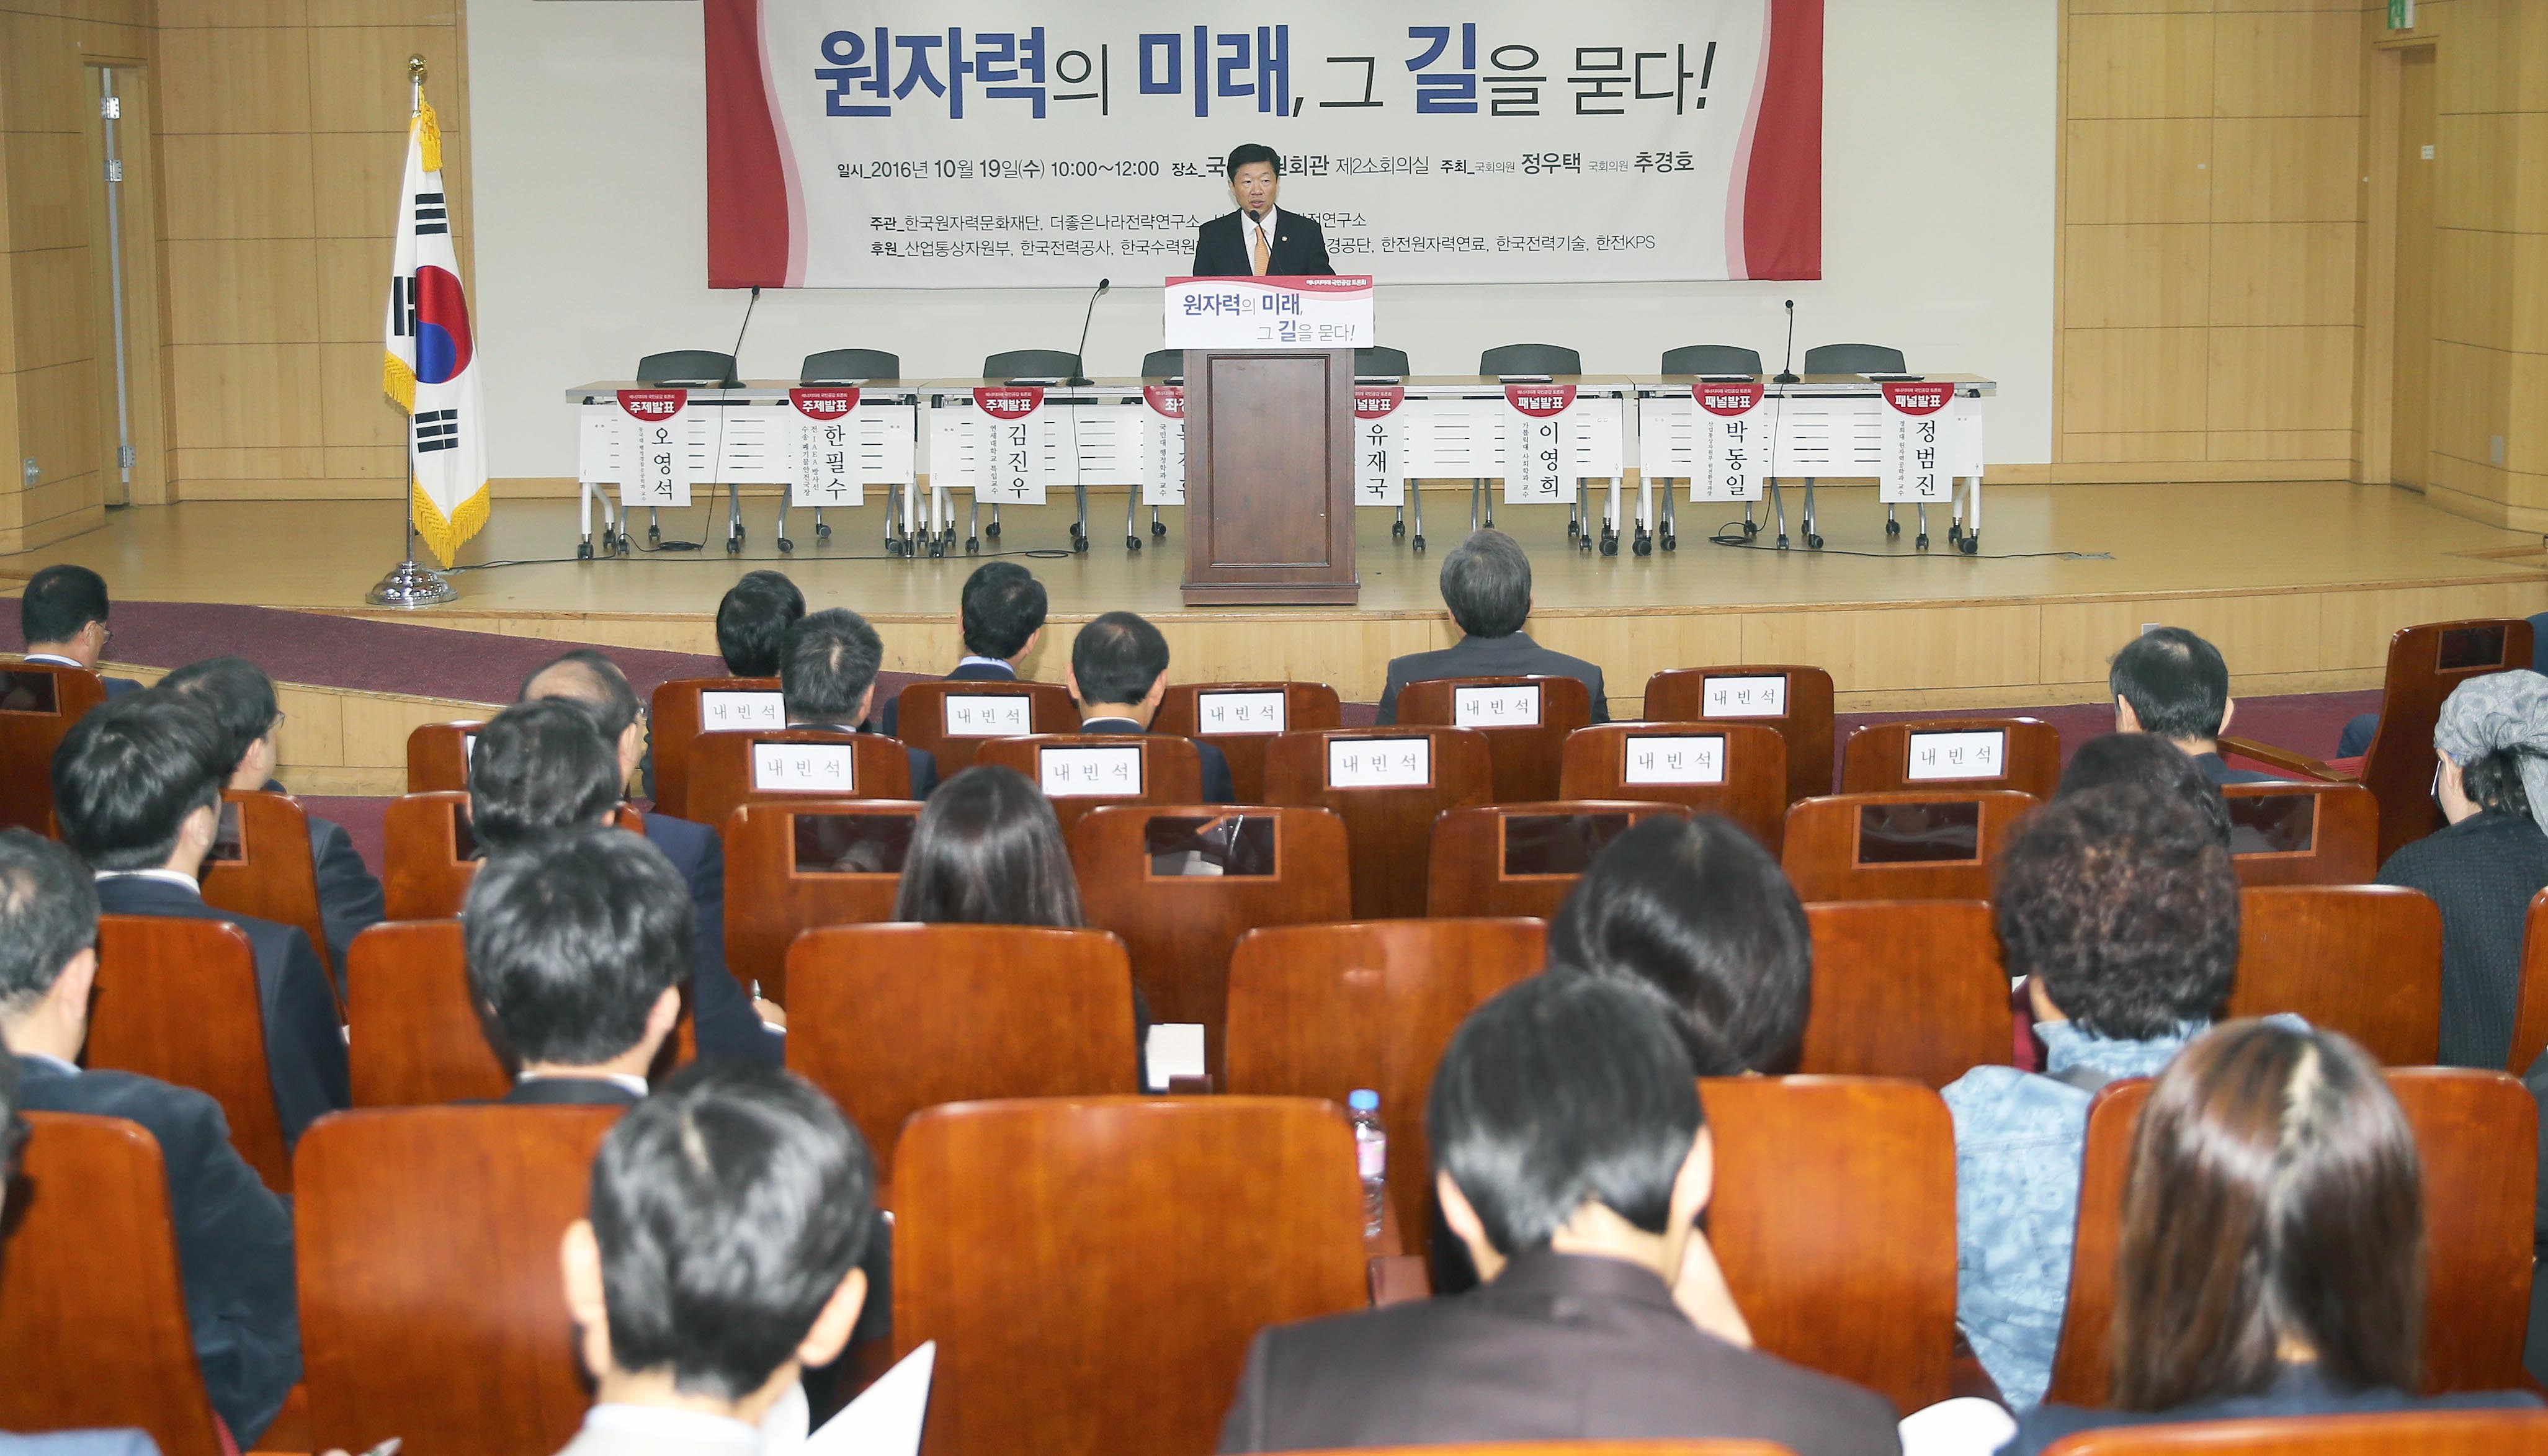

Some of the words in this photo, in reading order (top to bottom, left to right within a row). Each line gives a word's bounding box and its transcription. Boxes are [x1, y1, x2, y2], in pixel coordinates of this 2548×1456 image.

[814, 26, 1109, 119] 원자력의
[1139, 25, 1304, 118] 미래,
[1319, 56, 1384, 108] 그
[1405, 22, 1547, 117] 길을
[1567, 41, 1717, 116] 묻다!
[934, 159, 973, 179] 10월
[980, 158, 1045, 179] 19일(수)
[1051, 161, 1160, 178] 10:00~12:00
[1336, 156, 1429, 176] 제2소회의실
[1521, 152, 1581, 174] 정우택
[1588, 159, 1629, 172] 국회의원
[1634, 150, 1695, 173] 추경호
[1050, 213, 1200, 231] 더좋은나라전략연구소
[1020, 239, 1115, 257] 한국전력공사,
[1120, 238, 1199, 256] 한국수력원
[1381, 235, 1490, 253] 한전원자력연료,
[1496, 234, 1589, 252] 한국전력기술,
[1596, 234, 1656, 251] 한전KPS
[1182, 293, 1256, 316] 원자력의
[1262, 293, 1303, 316] 미래,
[1257, 326, 1274, 340] 그
[1278, 319, 1313, 342] 길을
[1318, 323, 1356, 342] 묻다!
[630, 401, 676, 414] 주제발표
[802, 400, 848, 413] 주제발표
[986, 398, 1032, 412] 주제발표
[1354, 398, 1392, 411] 널발표
[1518, 396, 1564, 410] 패널발표
[1705, 395, 1751, 409] 패널발표
[1894, 394, 1941, 408] 패널발표
[651, 427, 674, 501] 오영석
[824, 424, 847, 501] 한필수
[1008, 423, 1030, 499] 김진우
[1366, 424, 1388, 500] 유재국
[1539, 421, 1558, 498] 이영희
[1725, 420, 1748, 496] 박동일
[1915, 419, 1936, 496] 정범진
[811, 468, 820, 491] 방사선
[1160, 482, 1167, 497] 교수
[1522, 484, 1529, 498] 교수
